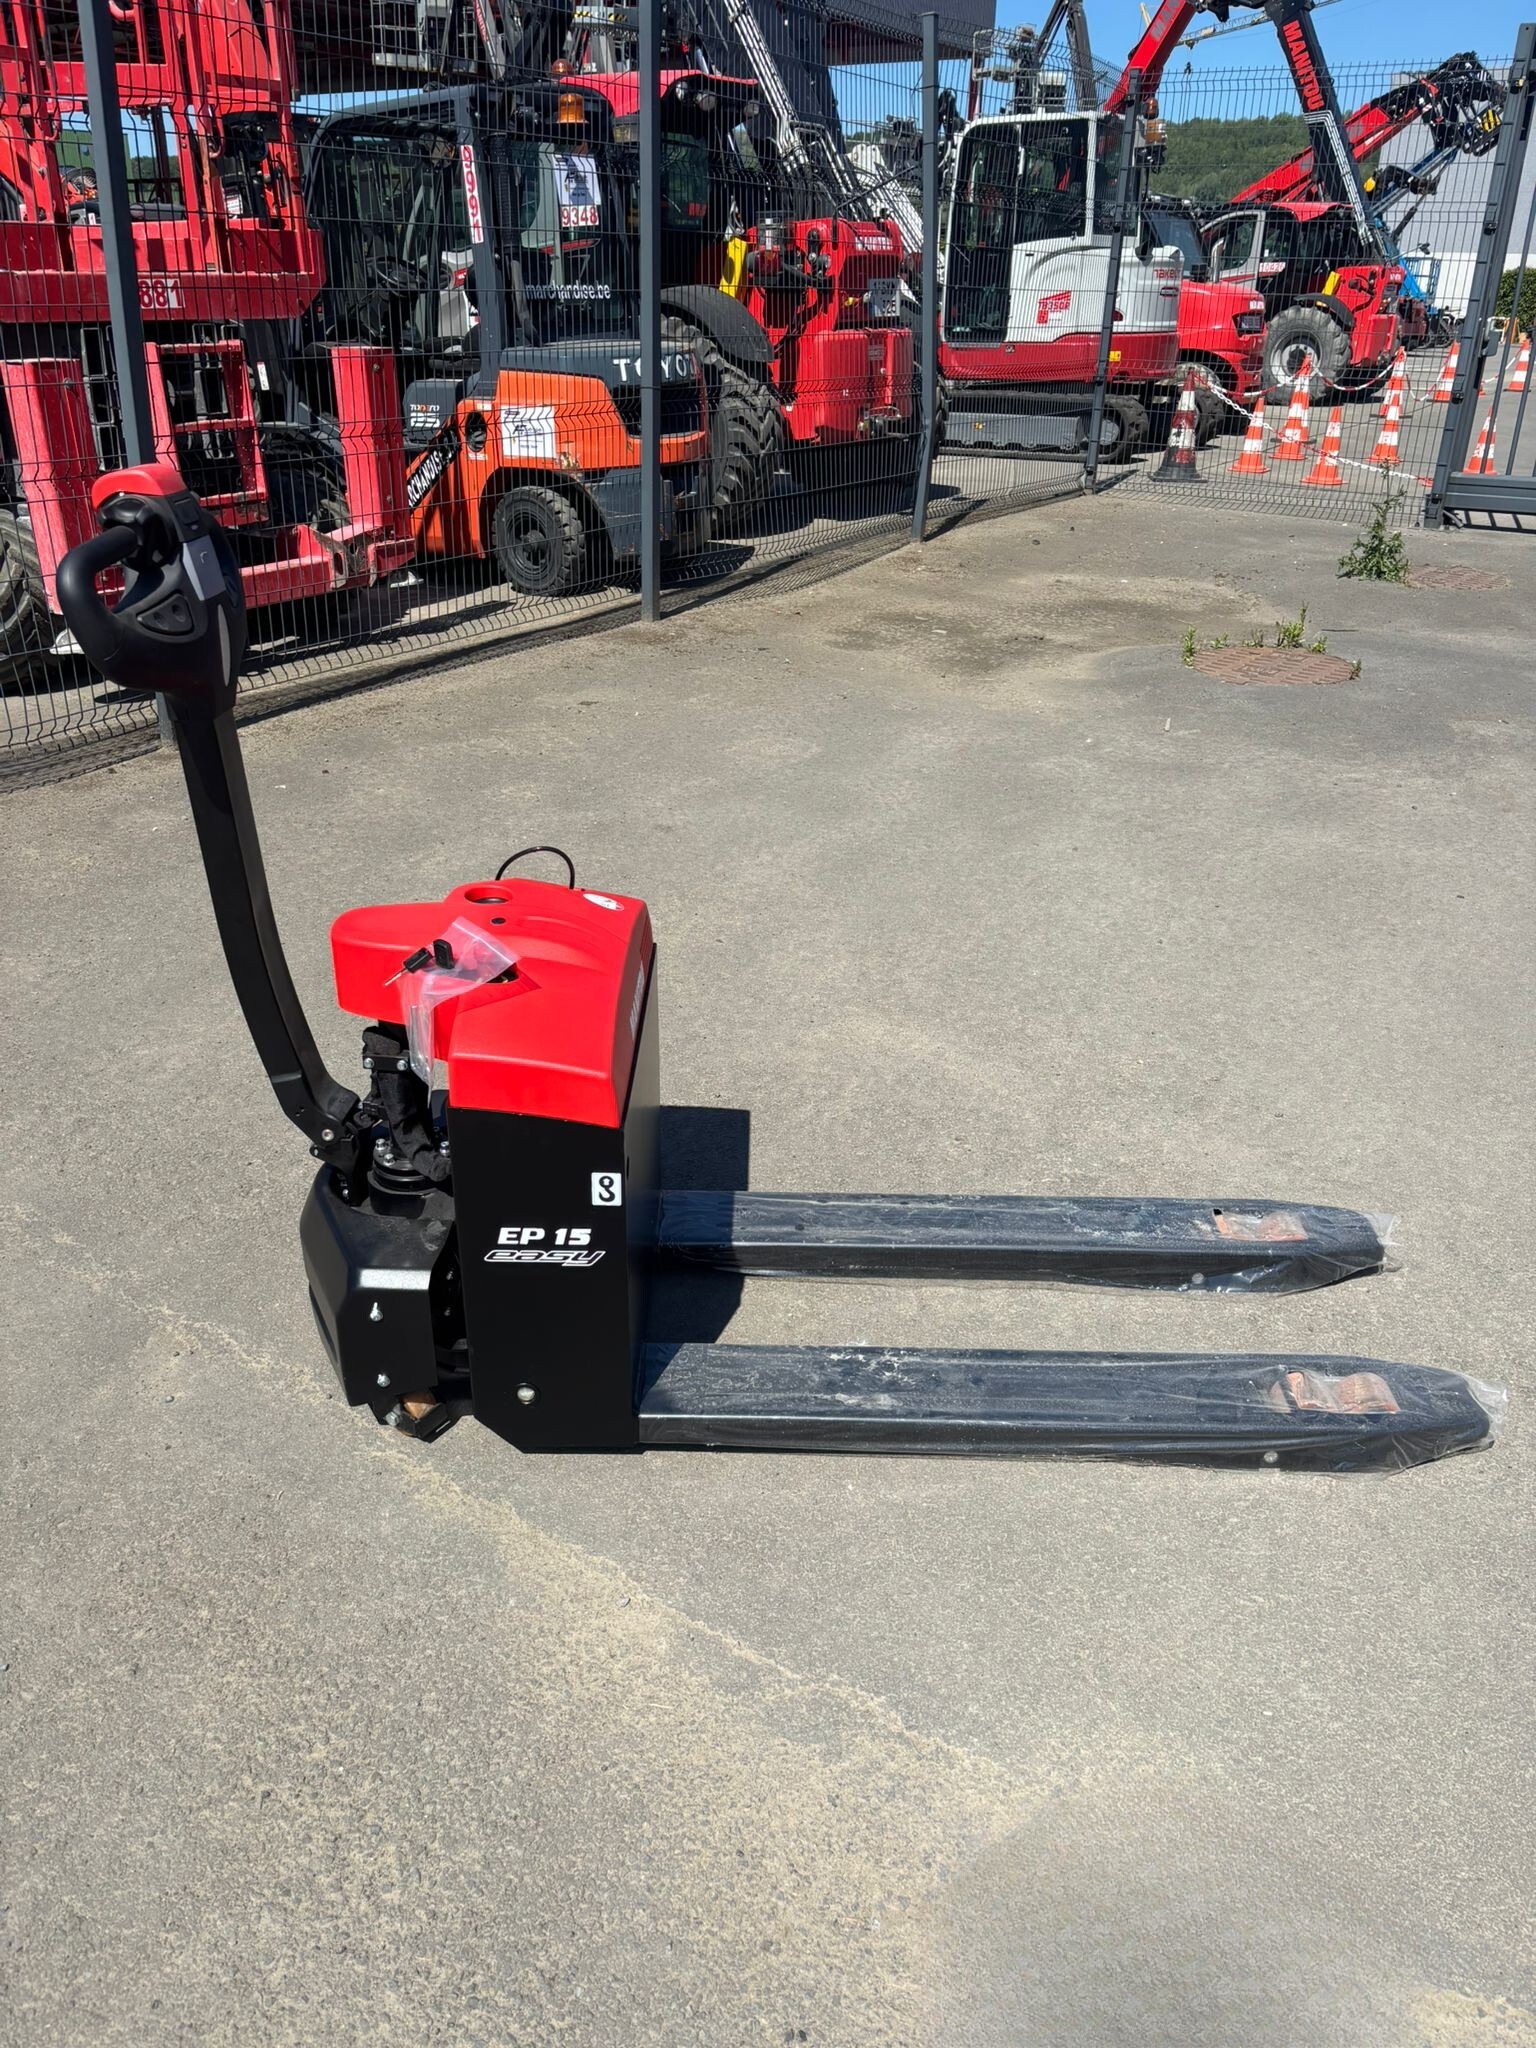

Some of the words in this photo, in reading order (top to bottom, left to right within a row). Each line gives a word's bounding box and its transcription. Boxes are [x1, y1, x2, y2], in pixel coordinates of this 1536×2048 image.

[1282, 19, 1325, 111] MANITOU
[561, 207, 598, 226] 9348
[525, 280, 611, 300] marchandise.be
[497, 1227, 545, 1246] EP
[554, 1227, 592, 1246] 15
[483, 1248, 607, 1267] easy
